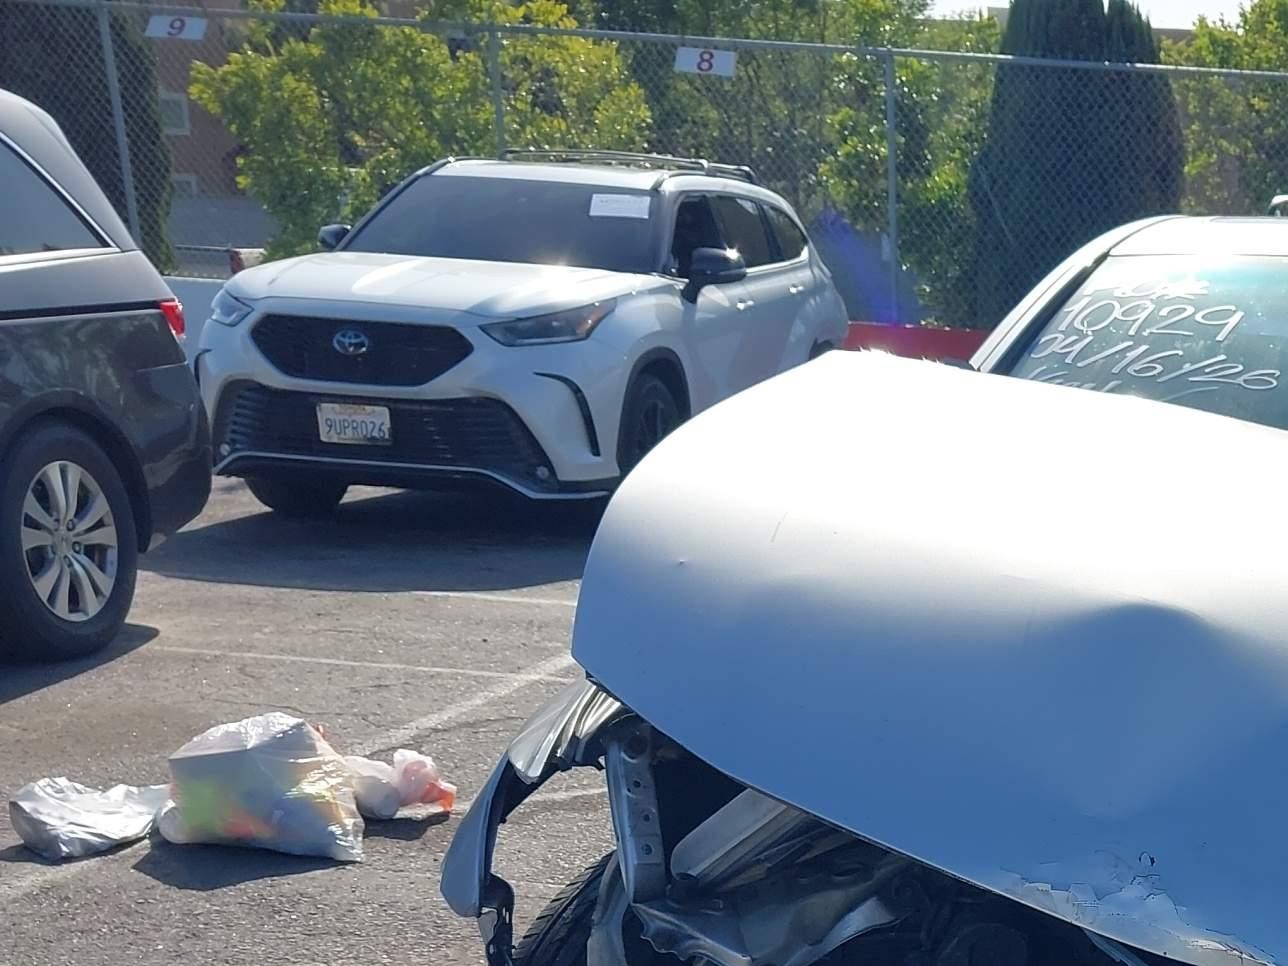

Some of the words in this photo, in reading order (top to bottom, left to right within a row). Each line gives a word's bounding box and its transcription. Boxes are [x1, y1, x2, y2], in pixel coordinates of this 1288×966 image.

[167, 17, 186, 36] 9
[697, 51, 714, 72] 8
[1058, 297, 1245, 342] 10929
